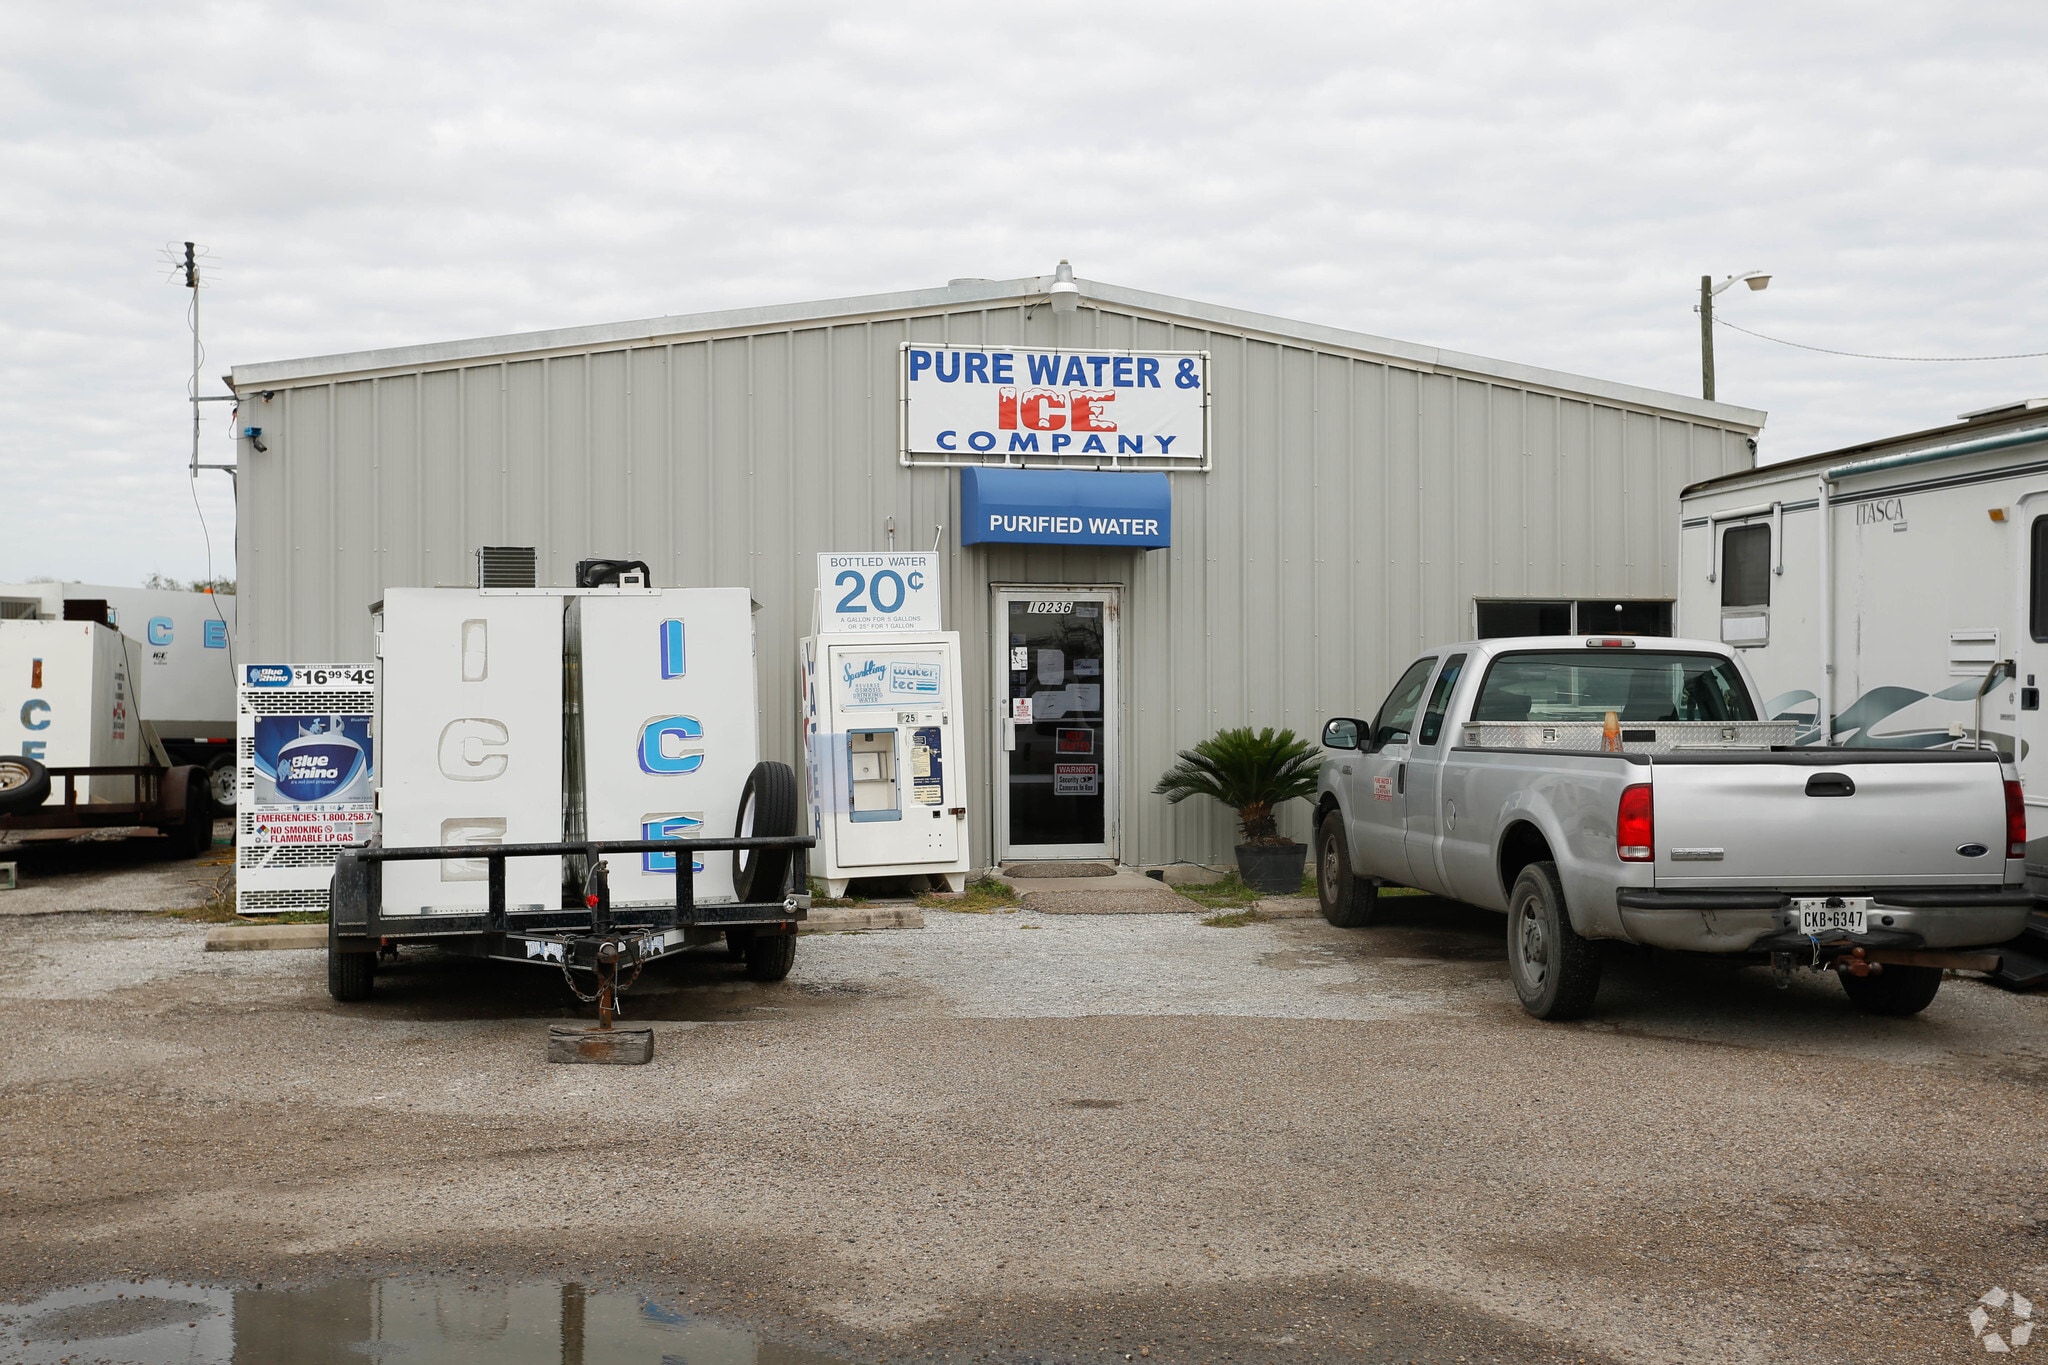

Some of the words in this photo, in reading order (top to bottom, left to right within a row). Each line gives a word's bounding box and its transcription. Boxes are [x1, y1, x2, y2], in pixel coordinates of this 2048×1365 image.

[909, 350, 1014, 385] PURE
[1027, 353, 1161, 389] WATER
[1174, 357, 1201, 390] &
[998, 386, 1118, 432] ICE
[936, 430, 1177, 454] COMPANY
[1856, 498, 1903, 526] ITASCA
[989, 514, 1083, 534] PURIFIED
[1088, 517, 1159, 536] WATER
[830, 557, 883, 567] BOTTLED
[888, 557, 926, 567] WATER
[1031, 602, 1072, 613] 10236
[843, 660, 887, 689] Sparkling
[892, 676, 914, 690] tec
[905, 714, 916, 723] 25
[292, 755, 329, 767] Blue
[288, 767, 338, 780] Rhino
[1058, 766, 1094, 774] WARNING
[1059, 776, 1079, 784] Security
[256, 813, 320, 823] EMERGENCIES:
[270, 826, 282, 834] NO
[284, 826, 323, 834] SMOKING
[270, 834, 323, 843] FLAMMABLE
[325, 834, 335, 842] LP
[337, 833, 354, 841] GAS
